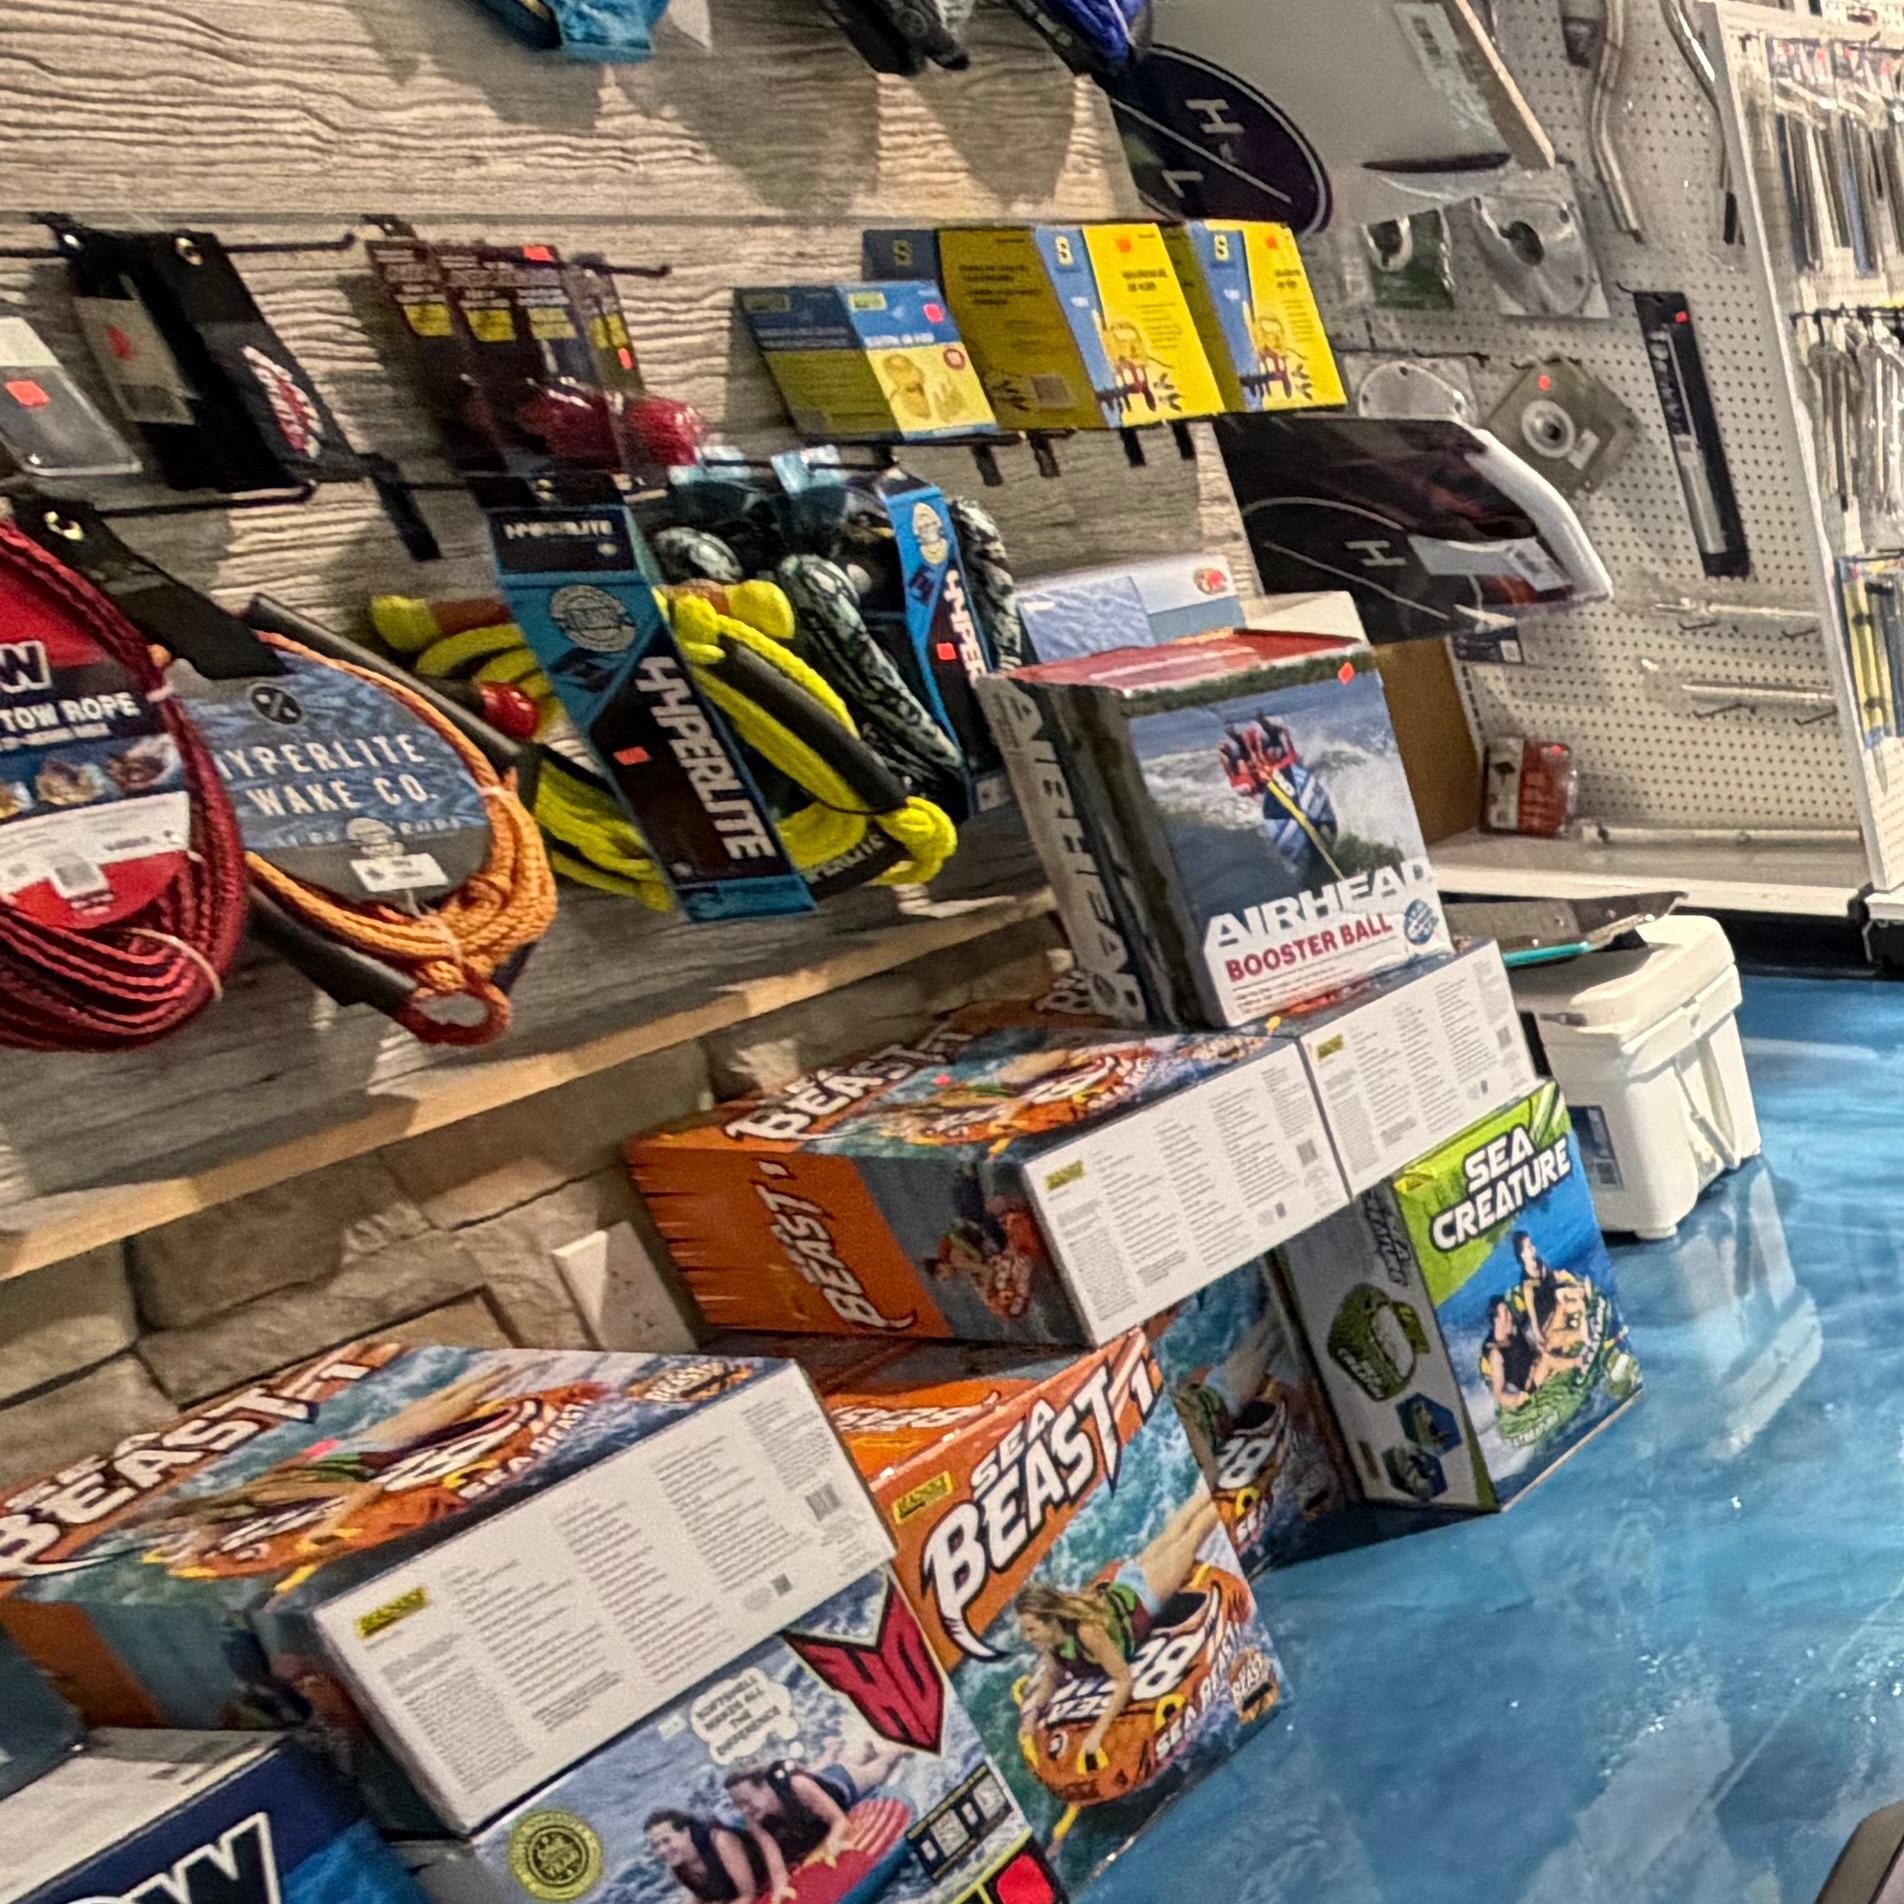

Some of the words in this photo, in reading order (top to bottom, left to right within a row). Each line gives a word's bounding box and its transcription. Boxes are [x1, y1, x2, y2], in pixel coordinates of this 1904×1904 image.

[1, 700, 58, 731] TOW
[61, 691, 141, 723] ROPE
[246, 779, 361, 817] WAKE
[373, 774, 438, 808] CO.
[634, 655, 777, 861] HYPERLITE
[1208, 857, 1432, 948] AIRHEAD
[1226, 928, 1338, 983] BOOSTER
[1339, 911, 1393, 946] BALL
[1432, 1138, 1572, 1251] CREATURE
[1463, 1124, 1536, 1192] SEA
[750, 1179, 917, 1330] BEAST
[970, 1399, 1059, 1490] SEA
[922, 1366, 1123, 1658] BEAST
